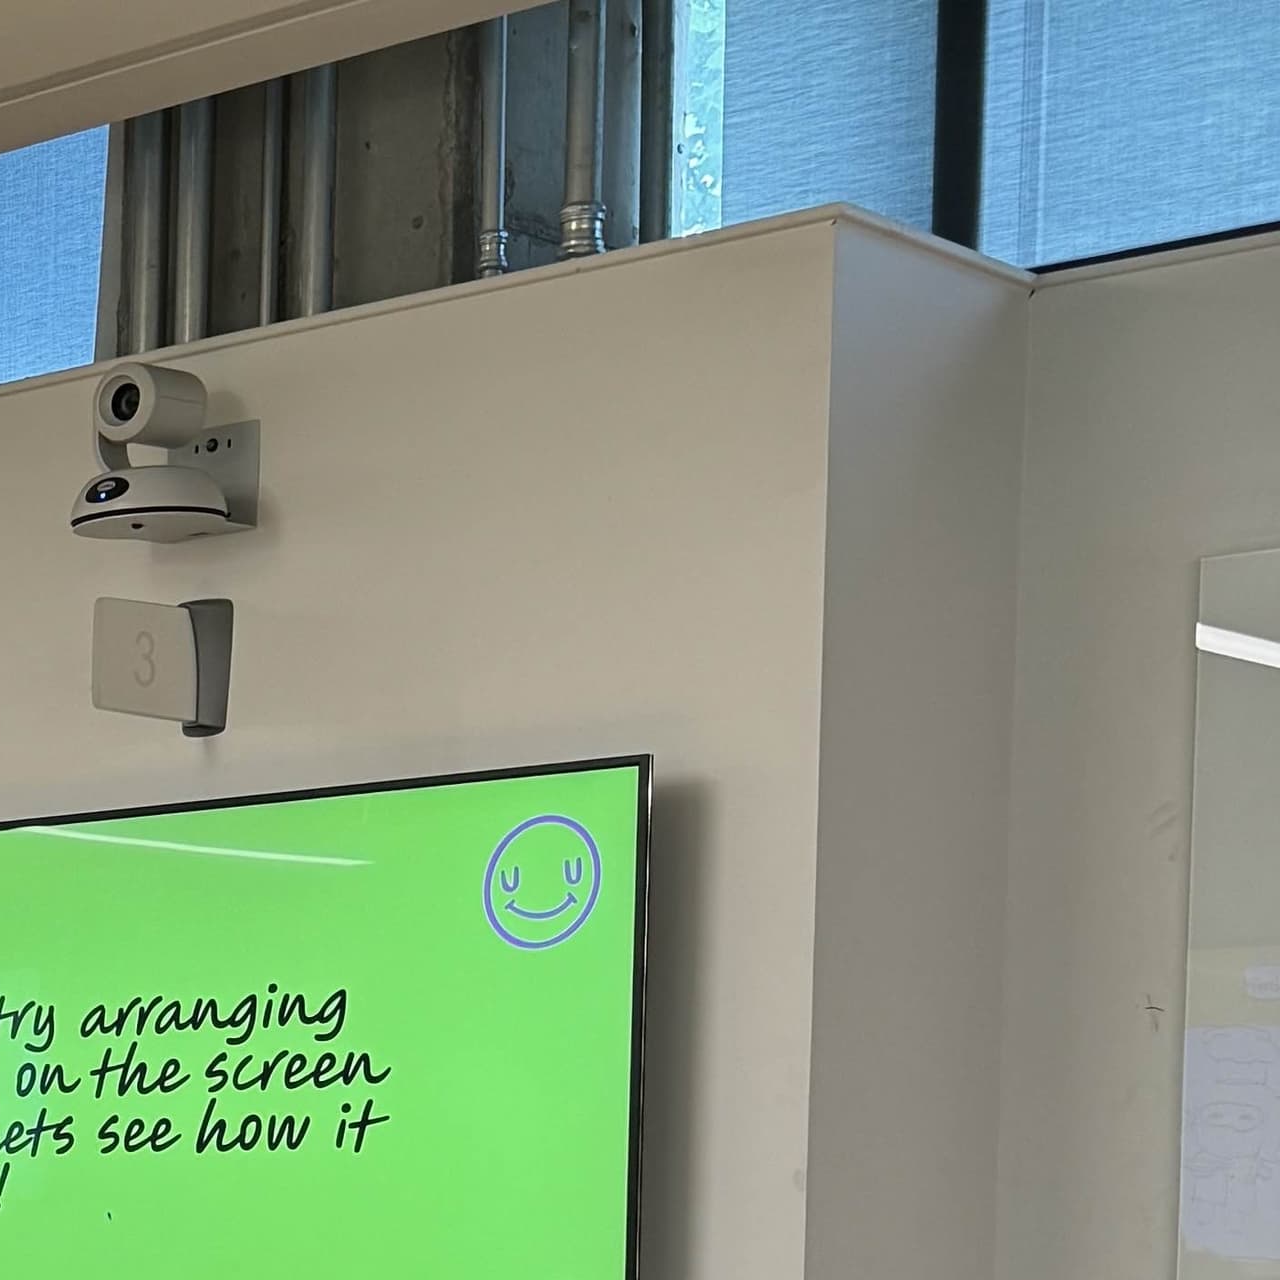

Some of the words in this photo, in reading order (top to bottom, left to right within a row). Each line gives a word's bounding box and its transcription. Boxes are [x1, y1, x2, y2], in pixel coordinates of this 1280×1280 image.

[79, 982, 348, 1046] arranging
[15, 1061, 83, 1099] on
[88, 1040, 192, 1100] the
[204, 1049, 393, 1094] screen
[96, 1113, 183, 1155] see
[194, 1096, 312, 1155] how
[334, 1098, 391, 1154] it
